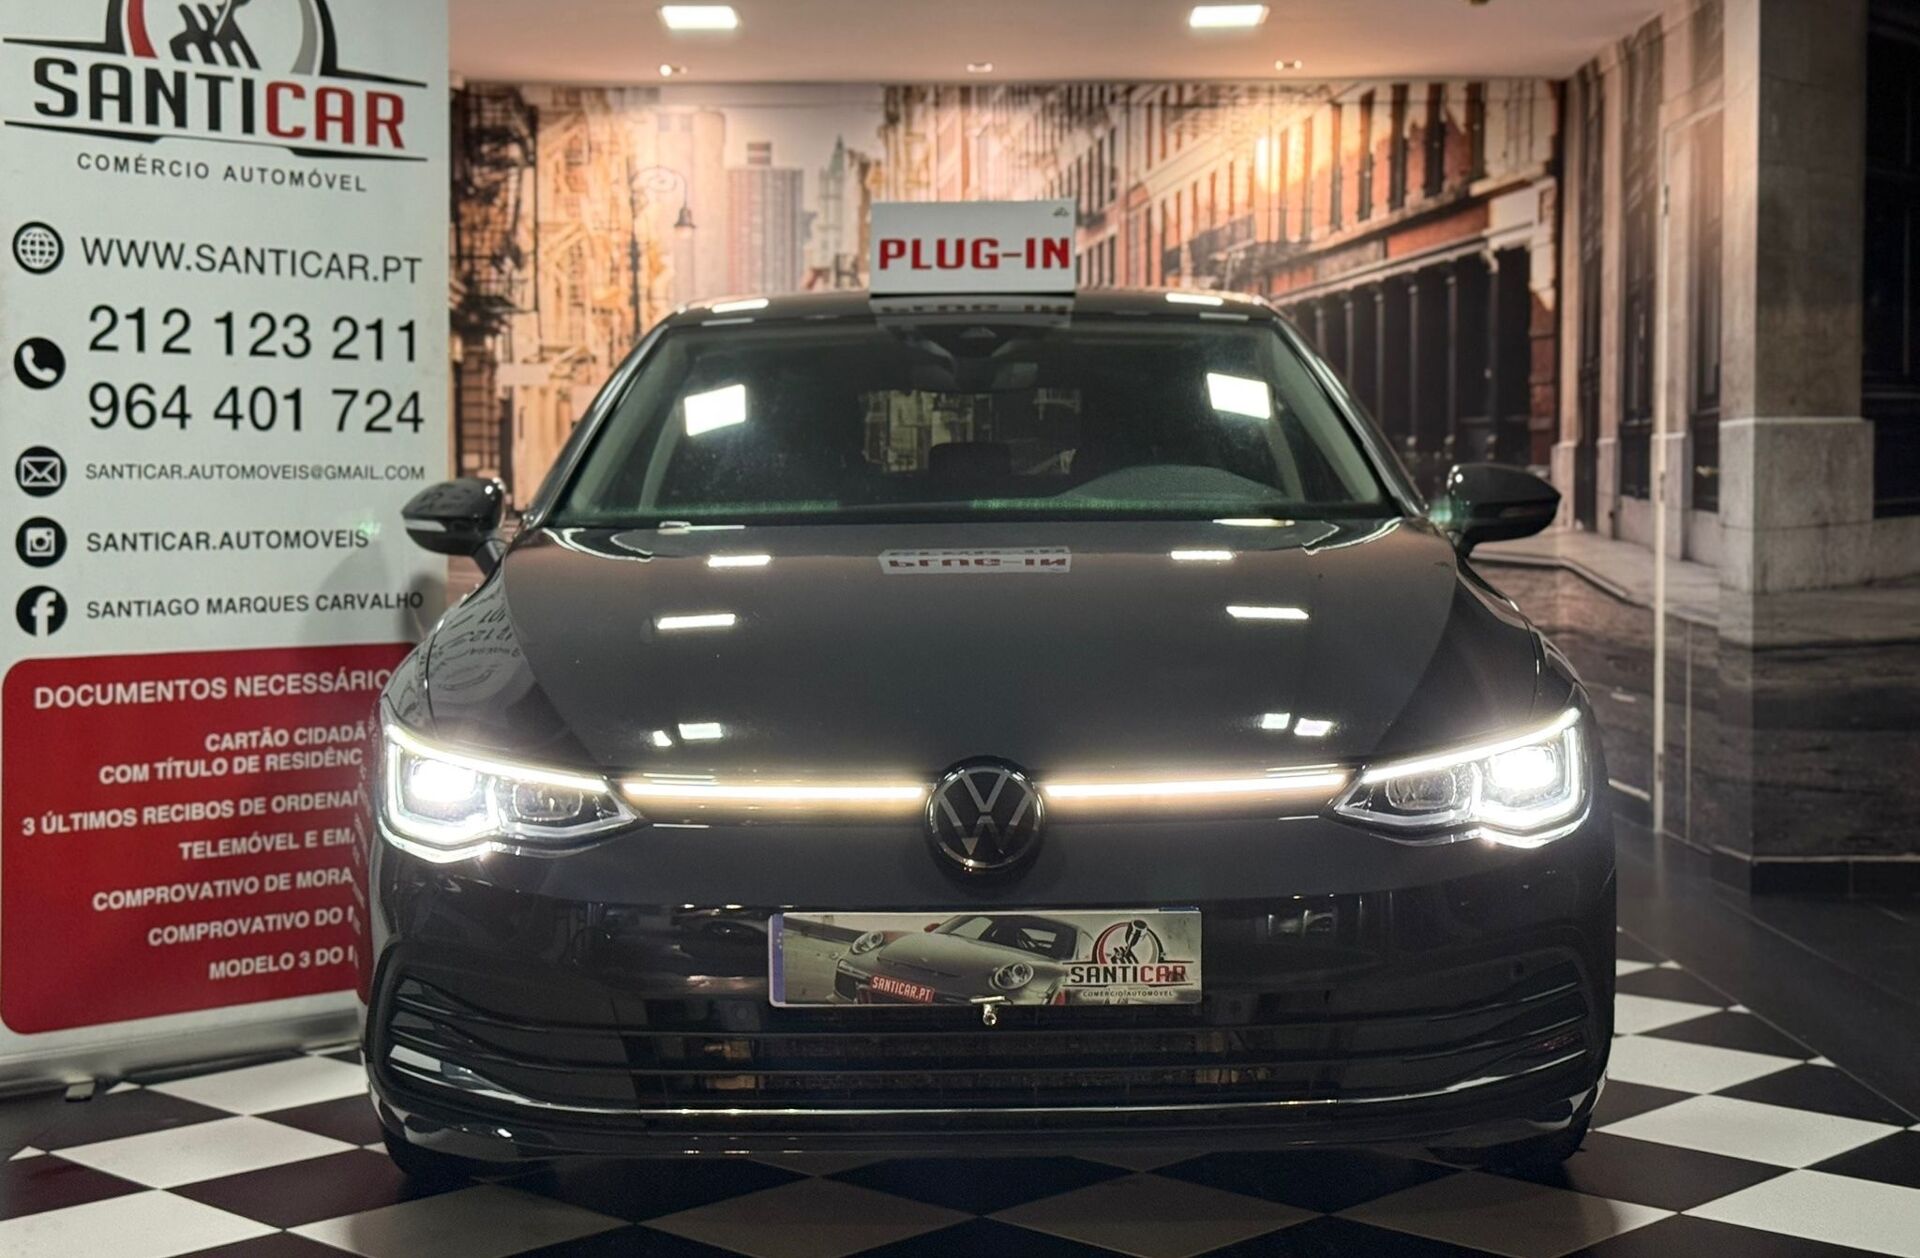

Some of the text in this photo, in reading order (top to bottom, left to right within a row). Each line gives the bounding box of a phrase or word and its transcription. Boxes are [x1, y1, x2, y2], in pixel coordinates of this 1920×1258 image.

[34, 57, 405, 149] SANTICAR
[77, 152, 367, 192] COMÉRCIO AUTOMÓVEL
[81, 236, 422, 284] WWW.SANTICAR.PT
[878, 237, 1070, 270] PLUG-IN
[88, 304, 417, 362] 212 123 211
[88, 381, 425, 433] 964 401 724
[85, 463, 426, 481] SANTICAR.AUTOMOVEIS@GMAIL.COM
[87, 529, 370, 552] SANTICAR.AUTOMOVEIS
[87, 592, 424, 619] SANTIAGO MARQUES CARVALHO
[34, 678, 227, 709] DOCUMENTOS
[205, 726, 290, 752] CARTÃO
[99, 764, 149, 785] COM
[154, 757, 229, 780] TÍTULO
[233, 756, 260, 775] DE
[22, 818, 36, 836] 3
[41, 809, 137, 835] ÚLTIMOS
[142, 801, 235, 824] RECIBOS
[239, 798, 266, 817] DE
[179, 827, 355, 860] TELEMÓVEL E EM
[92, 879, 260, 912] COMPROVATIVO
[264, 872, 292, 892] DE
[148, 909, 310, 947] COMPROVATIVO
[314, 907, 343, 927] DO
[209, 952, 295, 980] MODELO
[298, 950, 311, 969] 3
[315, 946, 344, 966] DO
[1070, 965, 1186, 984] SANTICAR
[872, 976, 932, 1002] SANTICAR.PT
